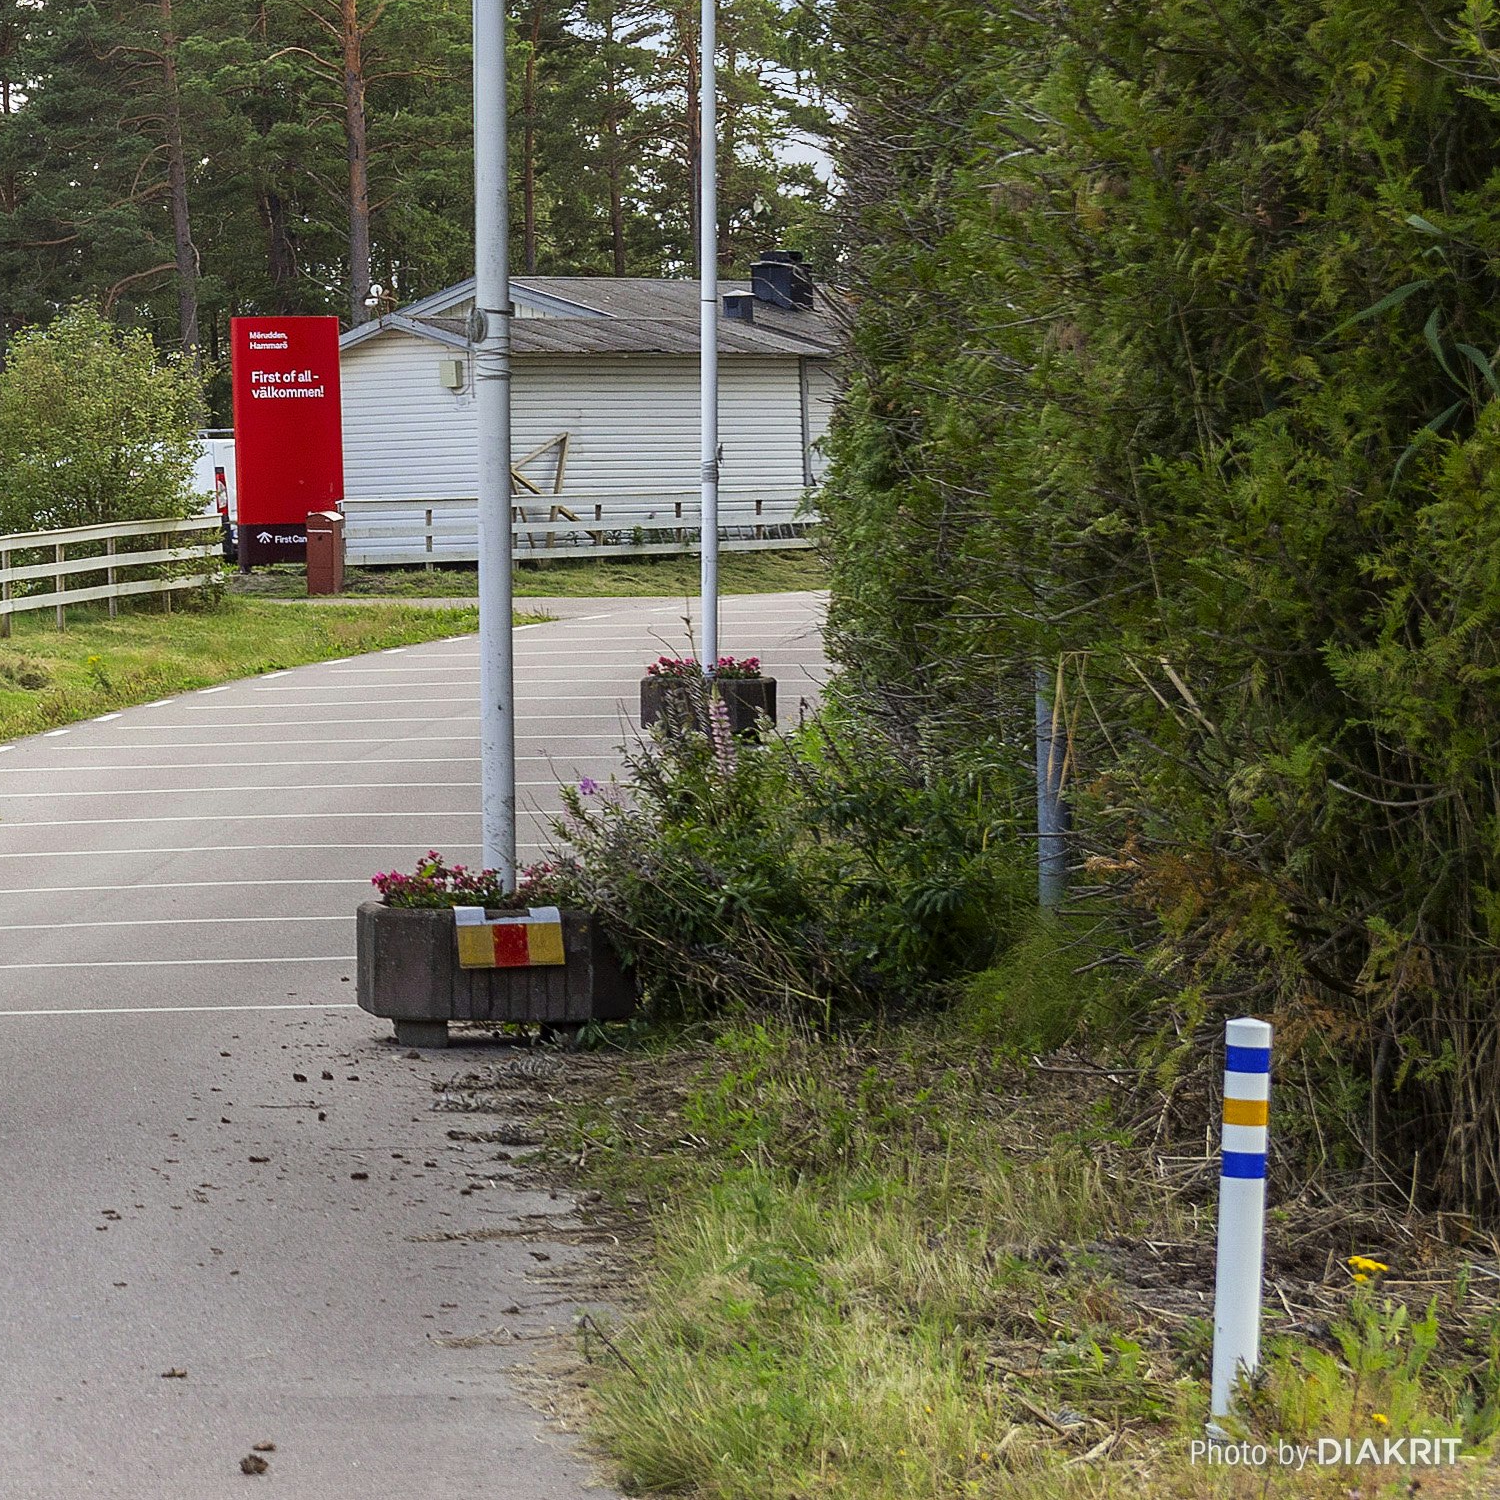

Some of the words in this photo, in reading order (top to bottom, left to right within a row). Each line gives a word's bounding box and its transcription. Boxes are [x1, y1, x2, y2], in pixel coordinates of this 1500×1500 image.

[249, 341, 288, 350] Hammarö
[251, 370, 281, 383] First
[282, 369, 297, 383] of
[297, 369, 312, 383] all
[251, 385, 325, 399] välkommen!
[274, 534, 292, 544] First
